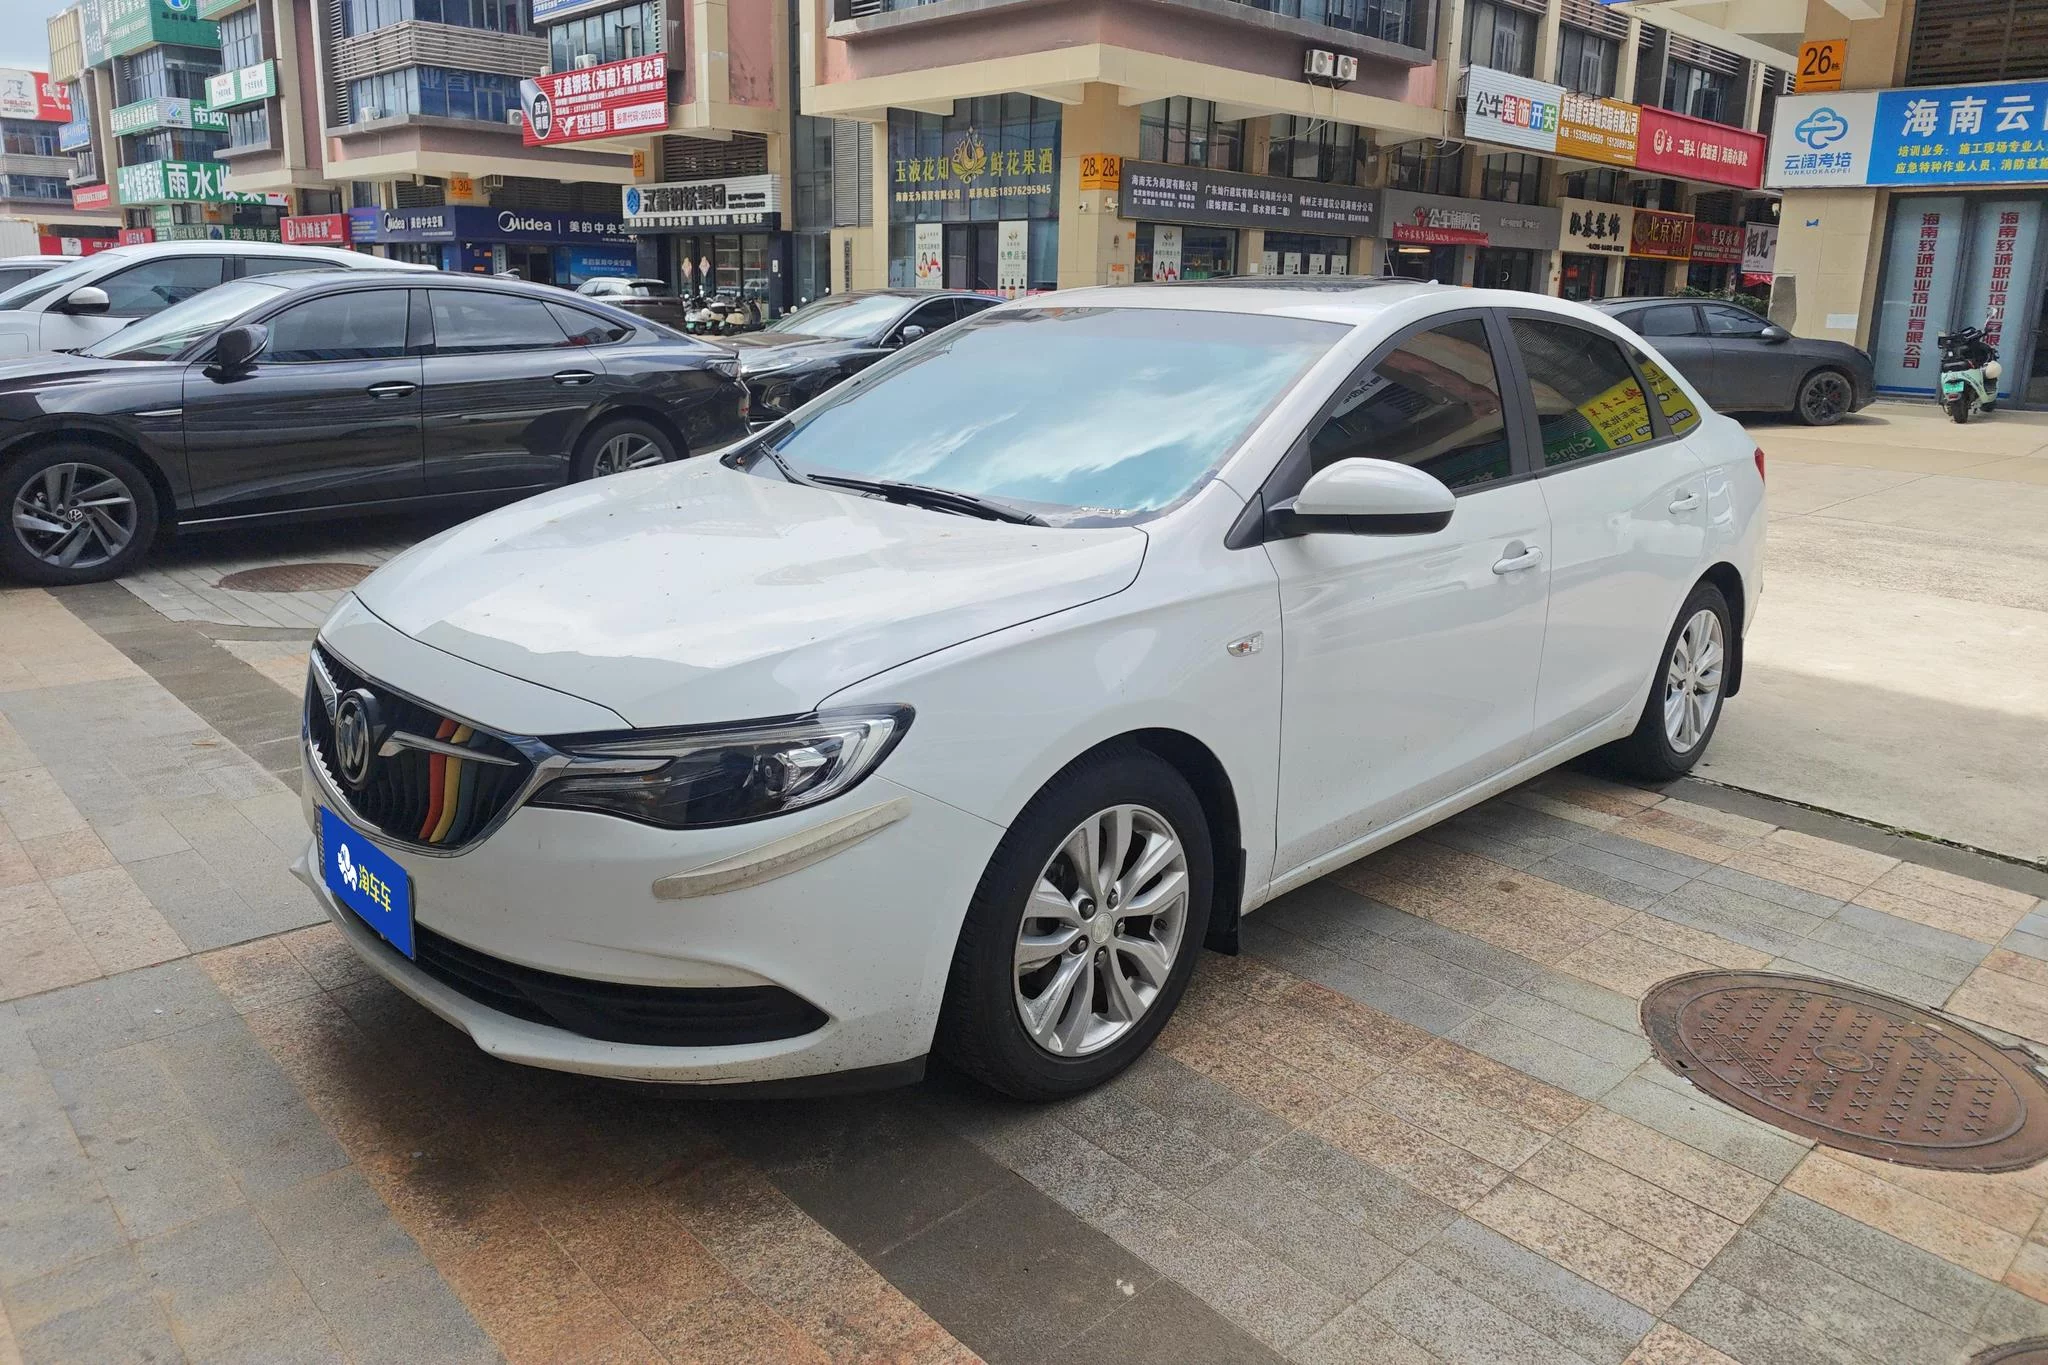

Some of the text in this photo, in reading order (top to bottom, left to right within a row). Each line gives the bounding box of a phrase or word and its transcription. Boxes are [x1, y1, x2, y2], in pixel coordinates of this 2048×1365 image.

[193, 107, 229, 127] 市政
[1475, 91, 1556, 132] 公牛装饰开关
[1902, 95, 2048, 137] 海南云
[1958, 139, 2048, 155] 施工现场专业人
[895, 156, 949, 183] 玉液花知
[990, 147, 1053, 177] 鲜花果酒
[1784, 152, 1852, 169] 云阔考培
[383, 212, 405, 232] Midea
[411, 216, 443, 229] 美的中央空调
[497, 211, 552, 232] Midea
[1429, 208, 1481, 231] 公牛旗舰店
[1648, 215, 1694, 244] 北京酒厂
[1902, 212, 1940, 369] 海南致诚职业培训有限公司
